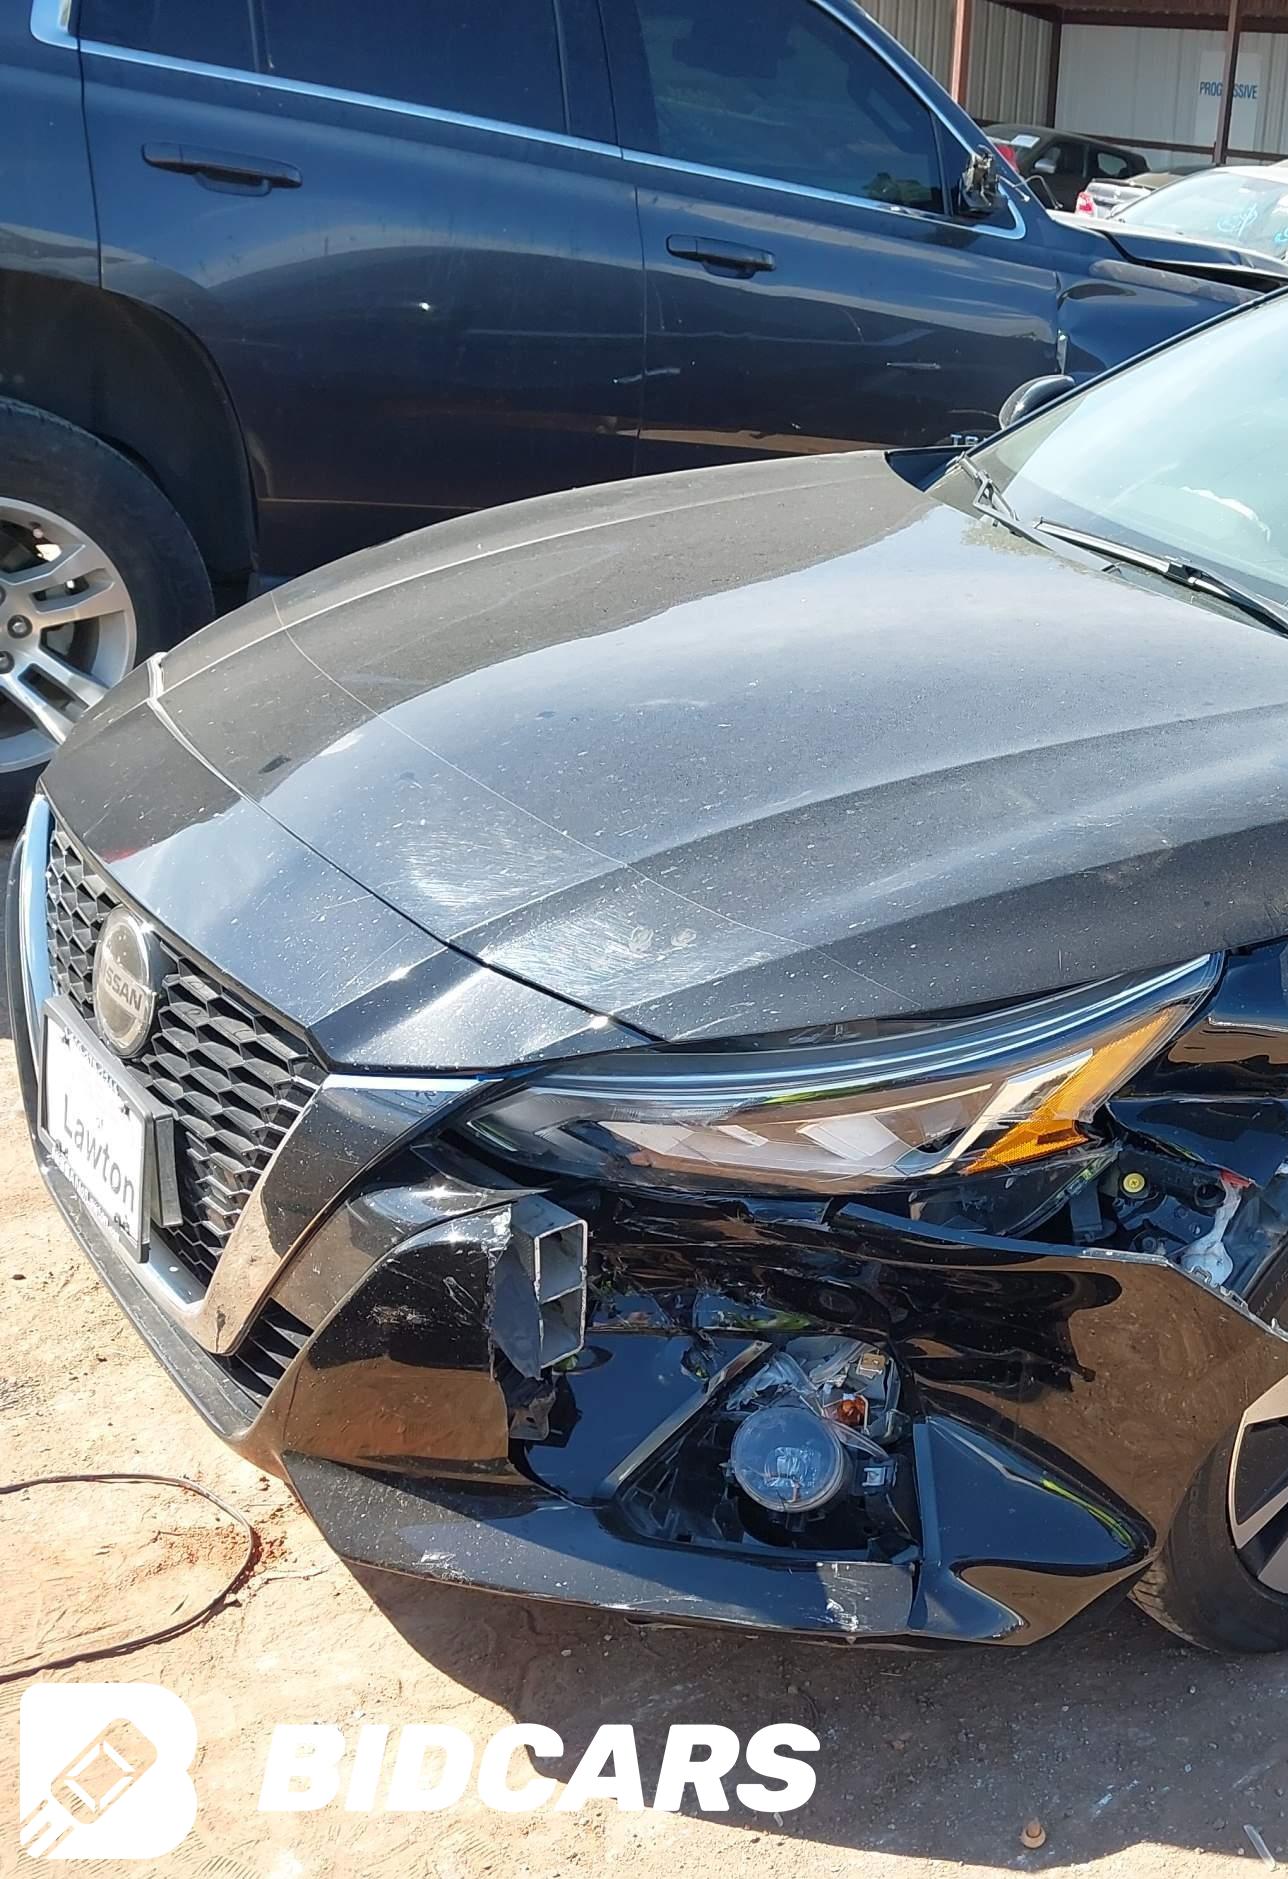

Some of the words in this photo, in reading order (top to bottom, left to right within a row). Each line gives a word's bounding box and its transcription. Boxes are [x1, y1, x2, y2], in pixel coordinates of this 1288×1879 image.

[1200, 81, 1258, 99] PROGSSIVE
[103, 962, 143, 1011] SSAN
[64, 1093, 134, 1213] Lawton
